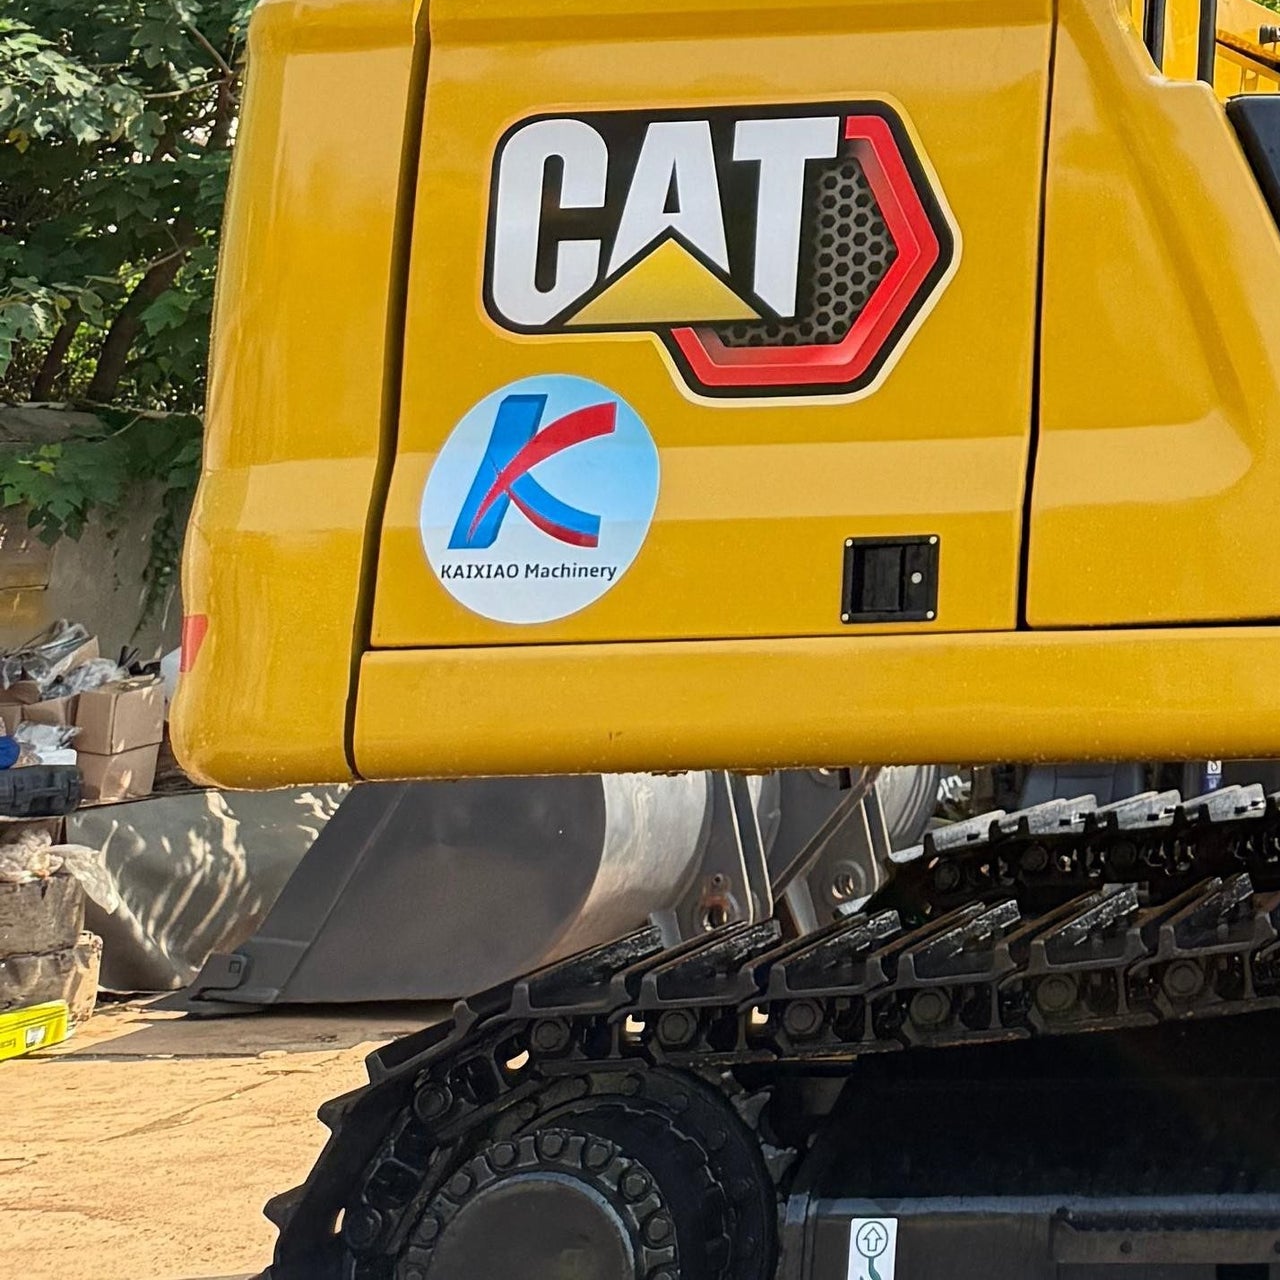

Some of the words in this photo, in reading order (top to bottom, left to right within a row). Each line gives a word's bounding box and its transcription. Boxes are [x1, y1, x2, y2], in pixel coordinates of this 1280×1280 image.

[492, 116, 840, 326] CAT
[441, 564, 519, 579] KAIXIAO
[525, 562, 617, 581] Machinery
